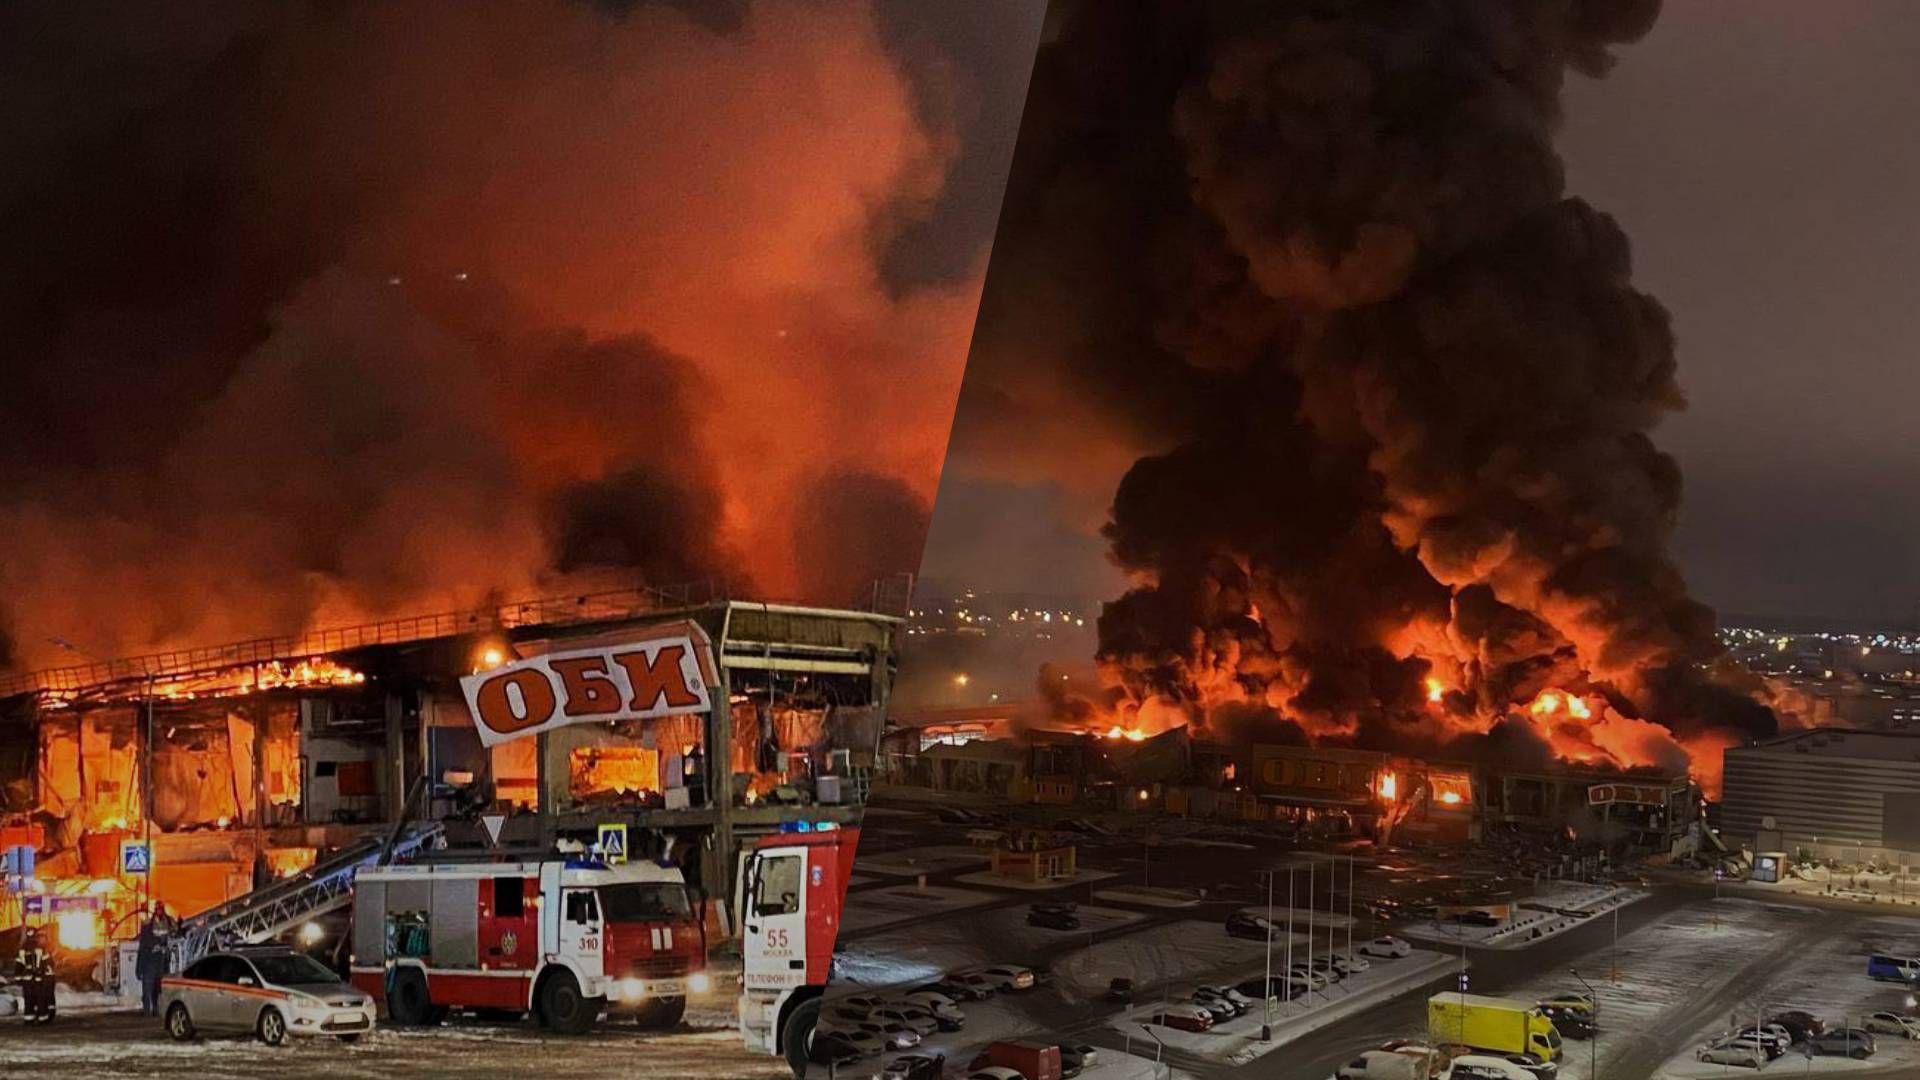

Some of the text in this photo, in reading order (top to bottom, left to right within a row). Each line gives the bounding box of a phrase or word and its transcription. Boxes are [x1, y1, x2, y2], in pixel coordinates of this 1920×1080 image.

[476, 645, 701, 734] ОБИ
[579, 937, 599, 951] 310
[767, 928, 788, 948] 55
